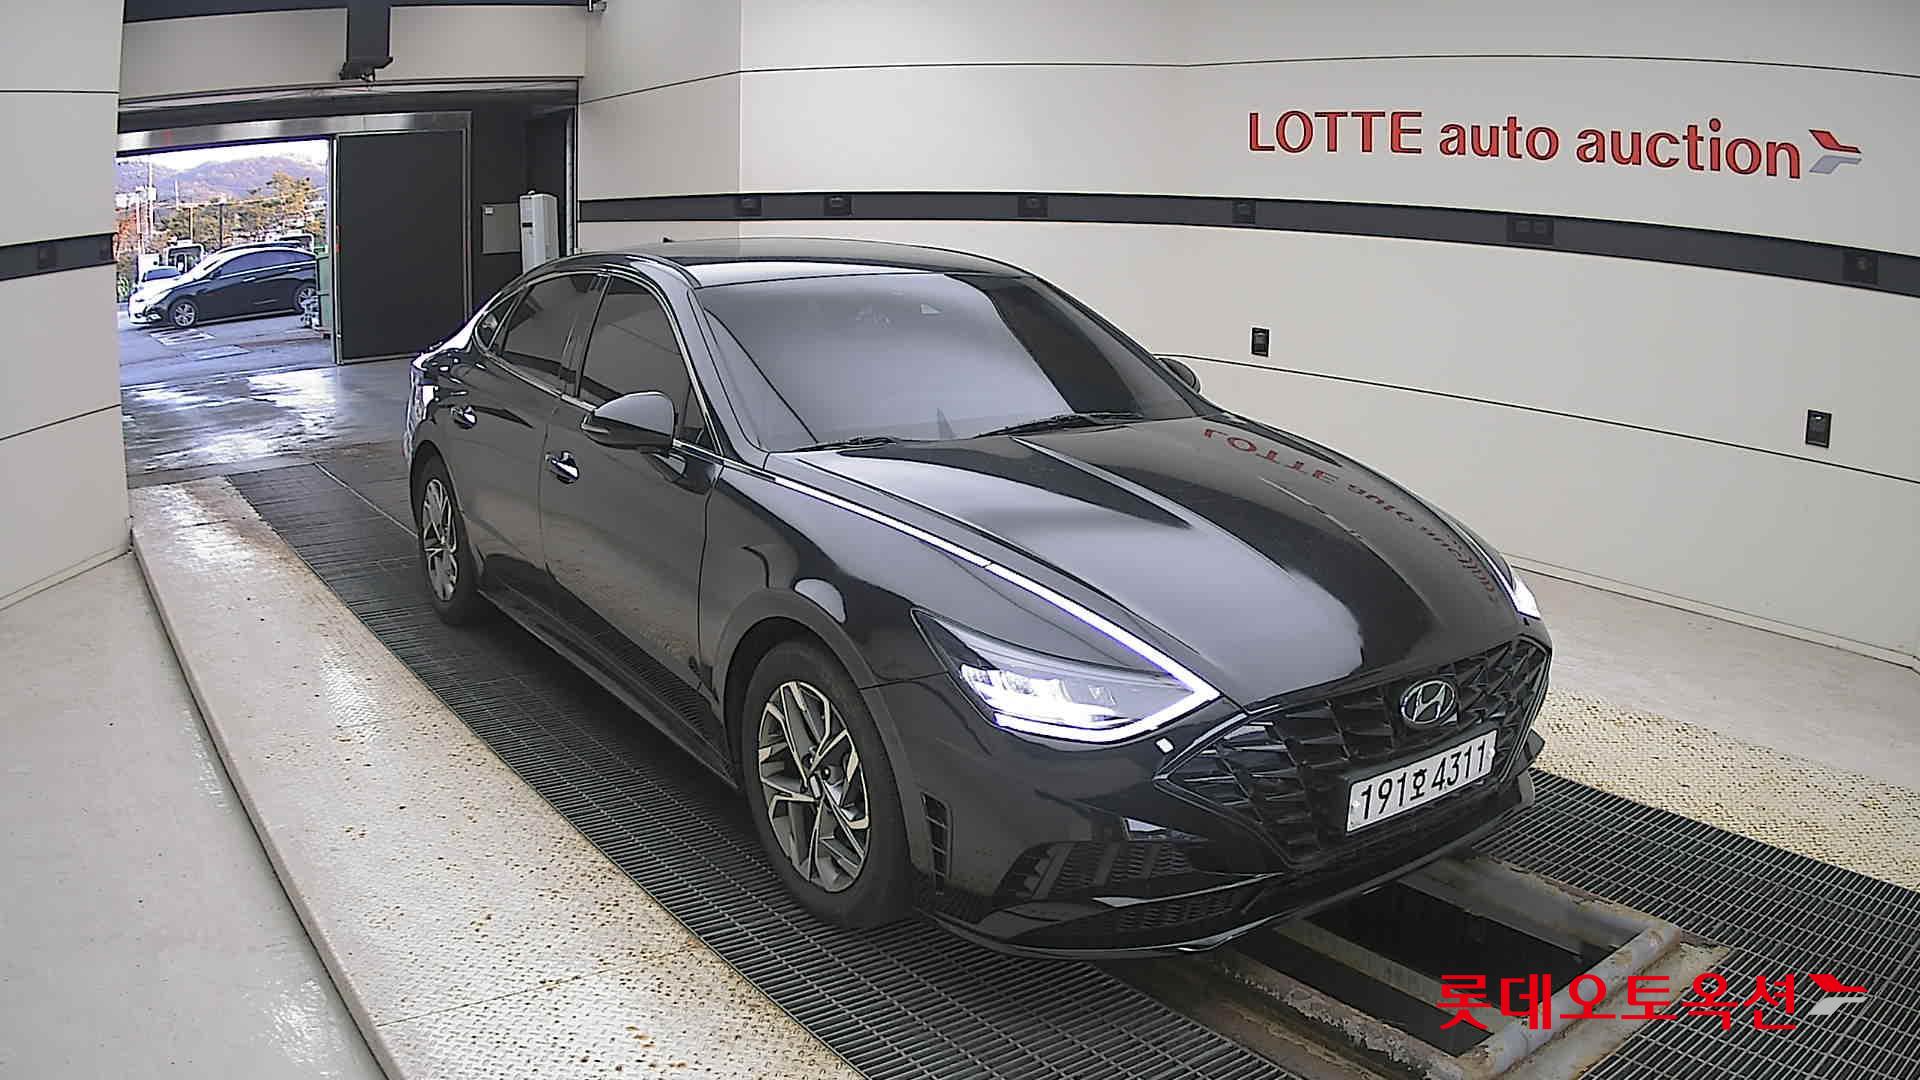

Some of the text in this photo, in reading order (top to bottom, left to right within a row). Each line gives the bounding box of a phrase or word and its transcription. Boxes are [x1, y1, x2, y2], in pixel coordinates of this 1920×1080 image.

[1248, 110, 1802, 180] LOTTE auto auction
[1431, 740, 1487, 791] 4311
